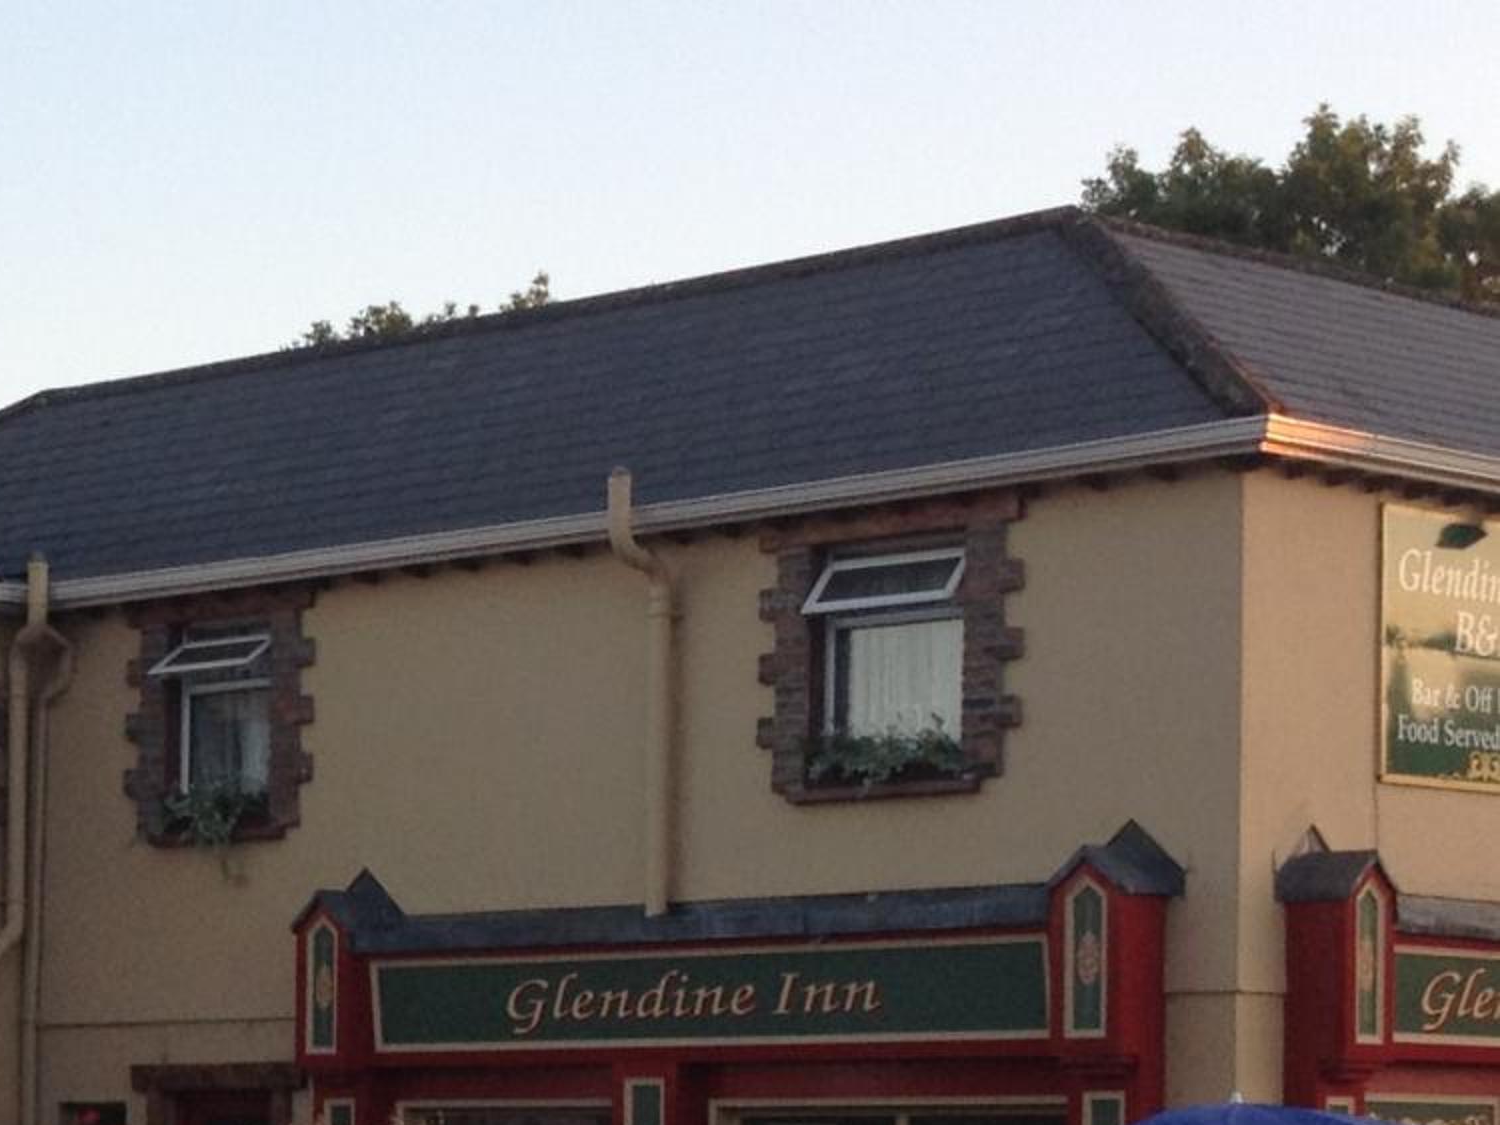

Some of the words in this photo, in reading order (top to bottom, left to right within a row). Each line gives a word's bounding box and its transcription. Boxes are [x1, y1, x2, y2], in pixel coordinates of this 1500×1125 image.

[1412, 678, 1439, 708] Bar
[1445, 683, 1461, 710] &
[1465, 686, 1492, 714] Off
[1398, 714, 1439, 746] Food
[506, 969, 755, 1034] Glendine
[772, 971, 882, 1016] Inn
